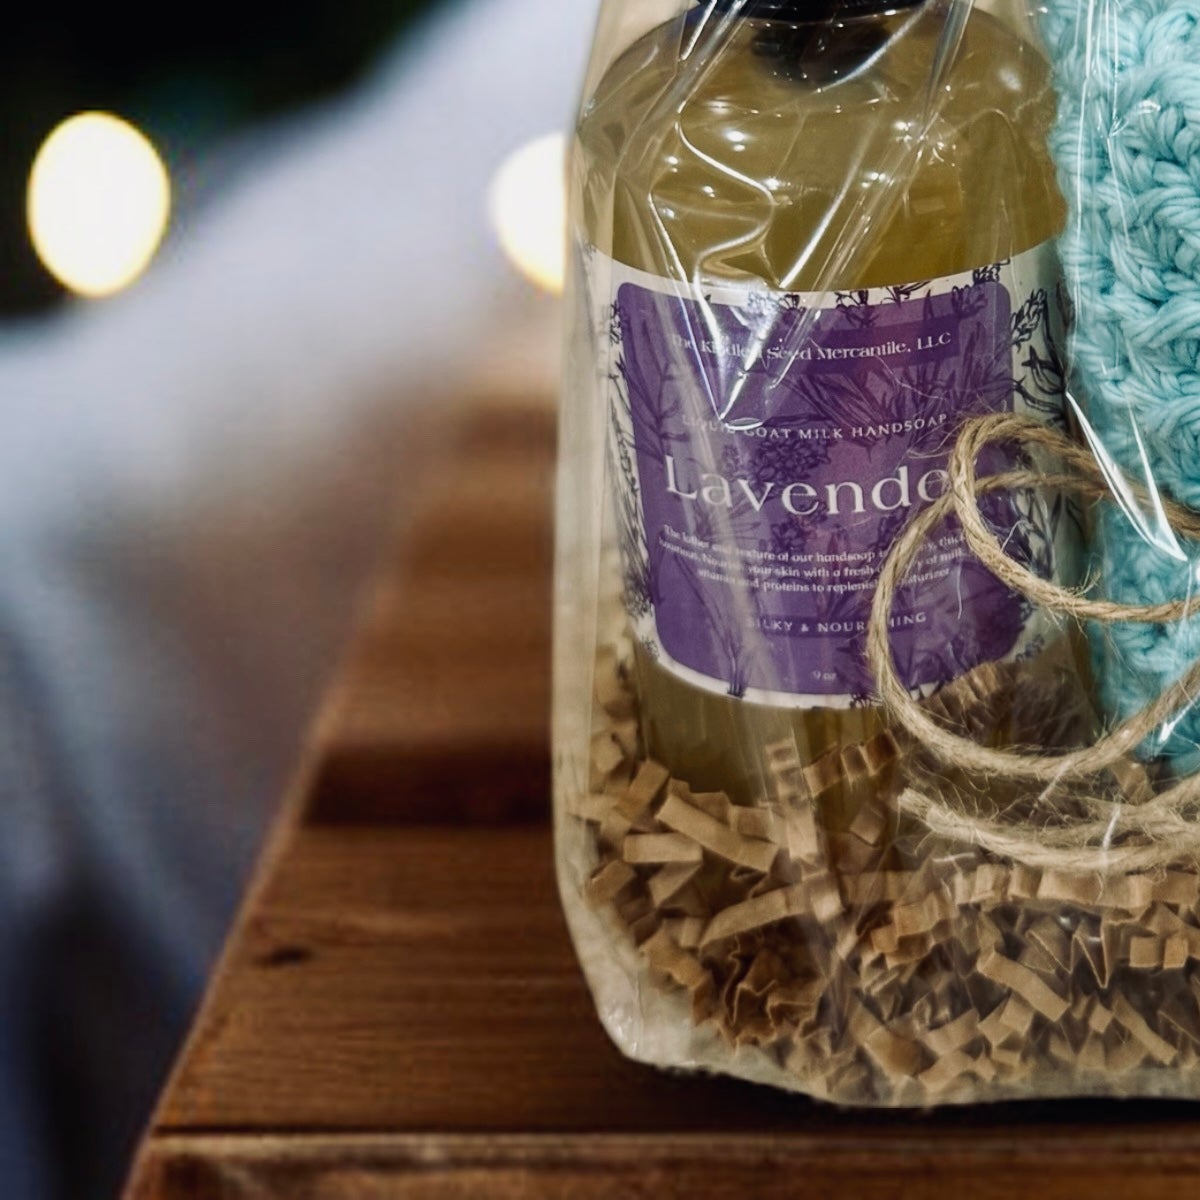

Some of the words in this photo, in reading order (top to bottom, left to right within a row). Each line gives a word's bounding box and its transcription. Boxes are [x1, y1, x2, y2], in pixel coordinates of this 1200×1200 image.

[917, 332, 951, 350] LLC
[800, 428, 843, 439] MILK
[852, 413, 947, 437] HANDSOAP
[665, 455, 953, 516] Lavende
[803, 567, 829, 578] with
[763, 580, 810, 592] proteins
[813, 581, 825, 592] to
[826, 579, 880, 594] replenis
[747, 618, 793, 632] ILKY
[818, 612, 927, 633] NOURING
